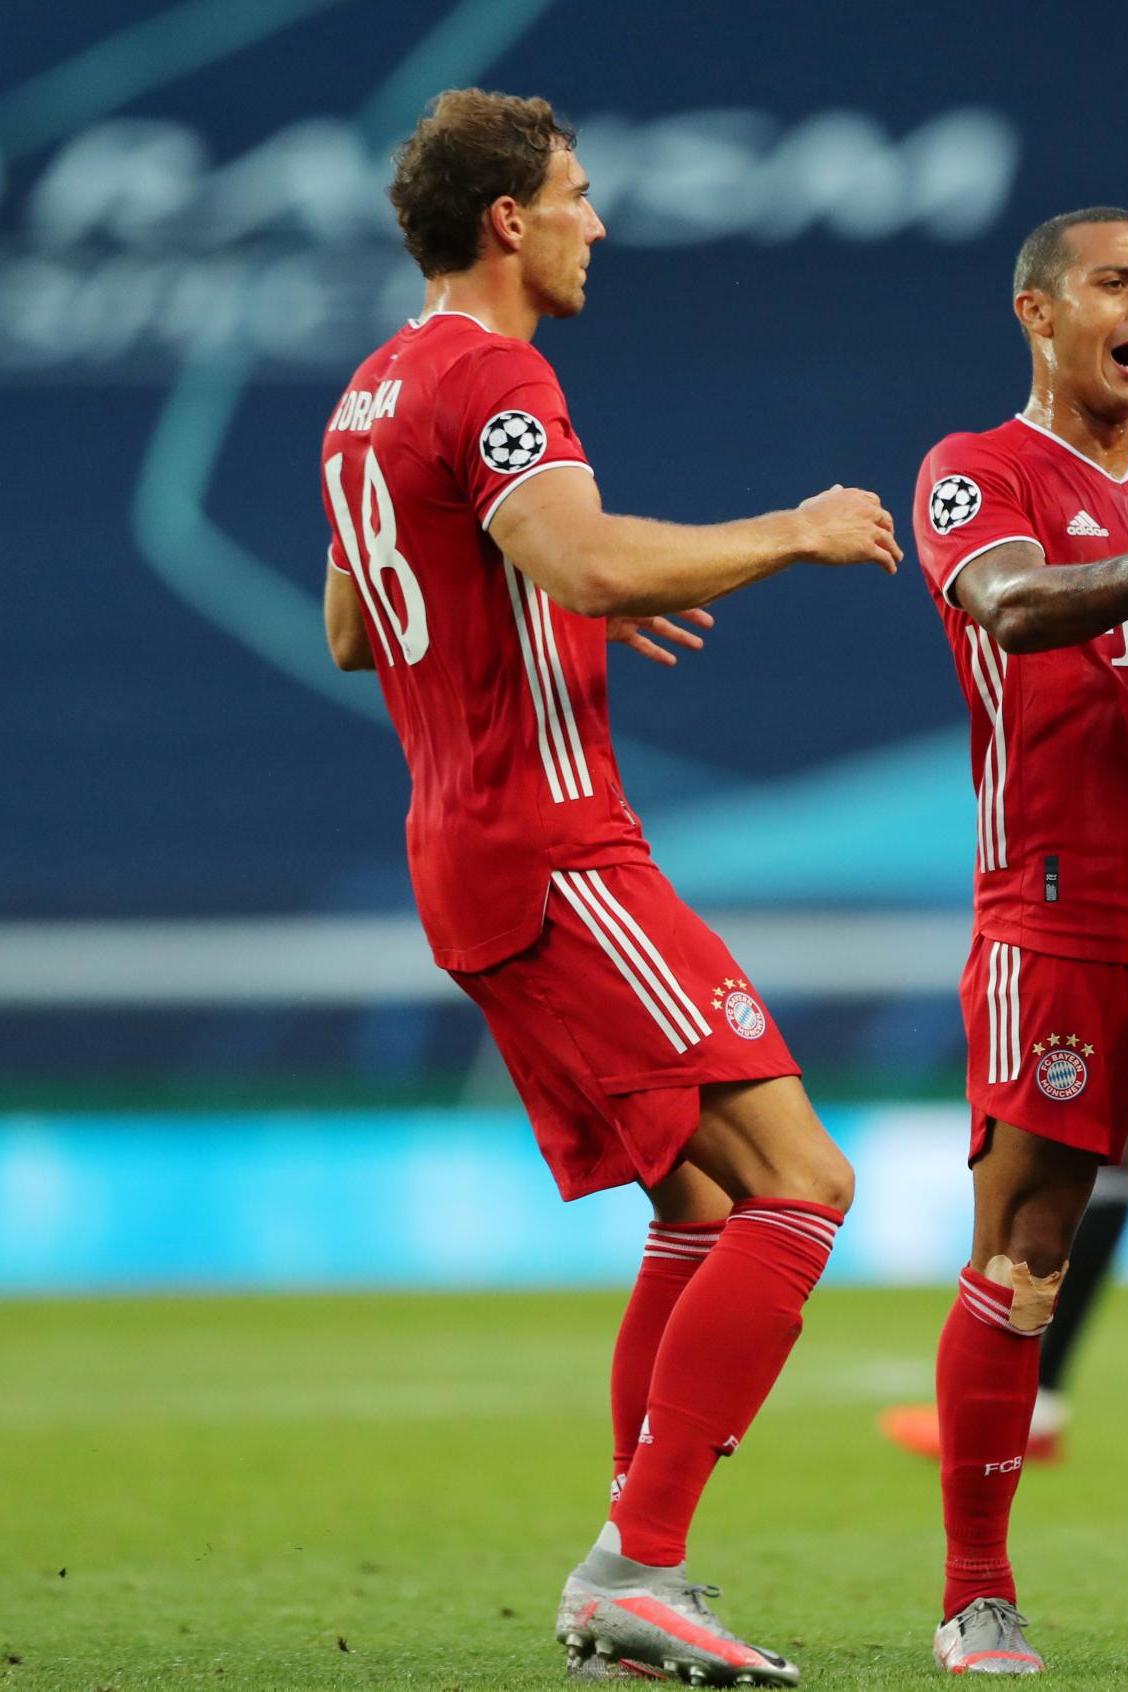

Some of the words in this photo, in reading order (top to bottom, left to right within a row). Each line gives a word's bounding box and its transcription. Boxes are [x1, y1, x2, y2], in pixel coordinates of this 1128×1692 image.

[1066, 525, 1109, 537] adidas
[325, 446, 430, 666] 18
[1041, 1060, 1052, 1072] FC
[1051, 1053, 1084, 1072] BAYERN
[984, 1455, 1022, 1476] FCB
